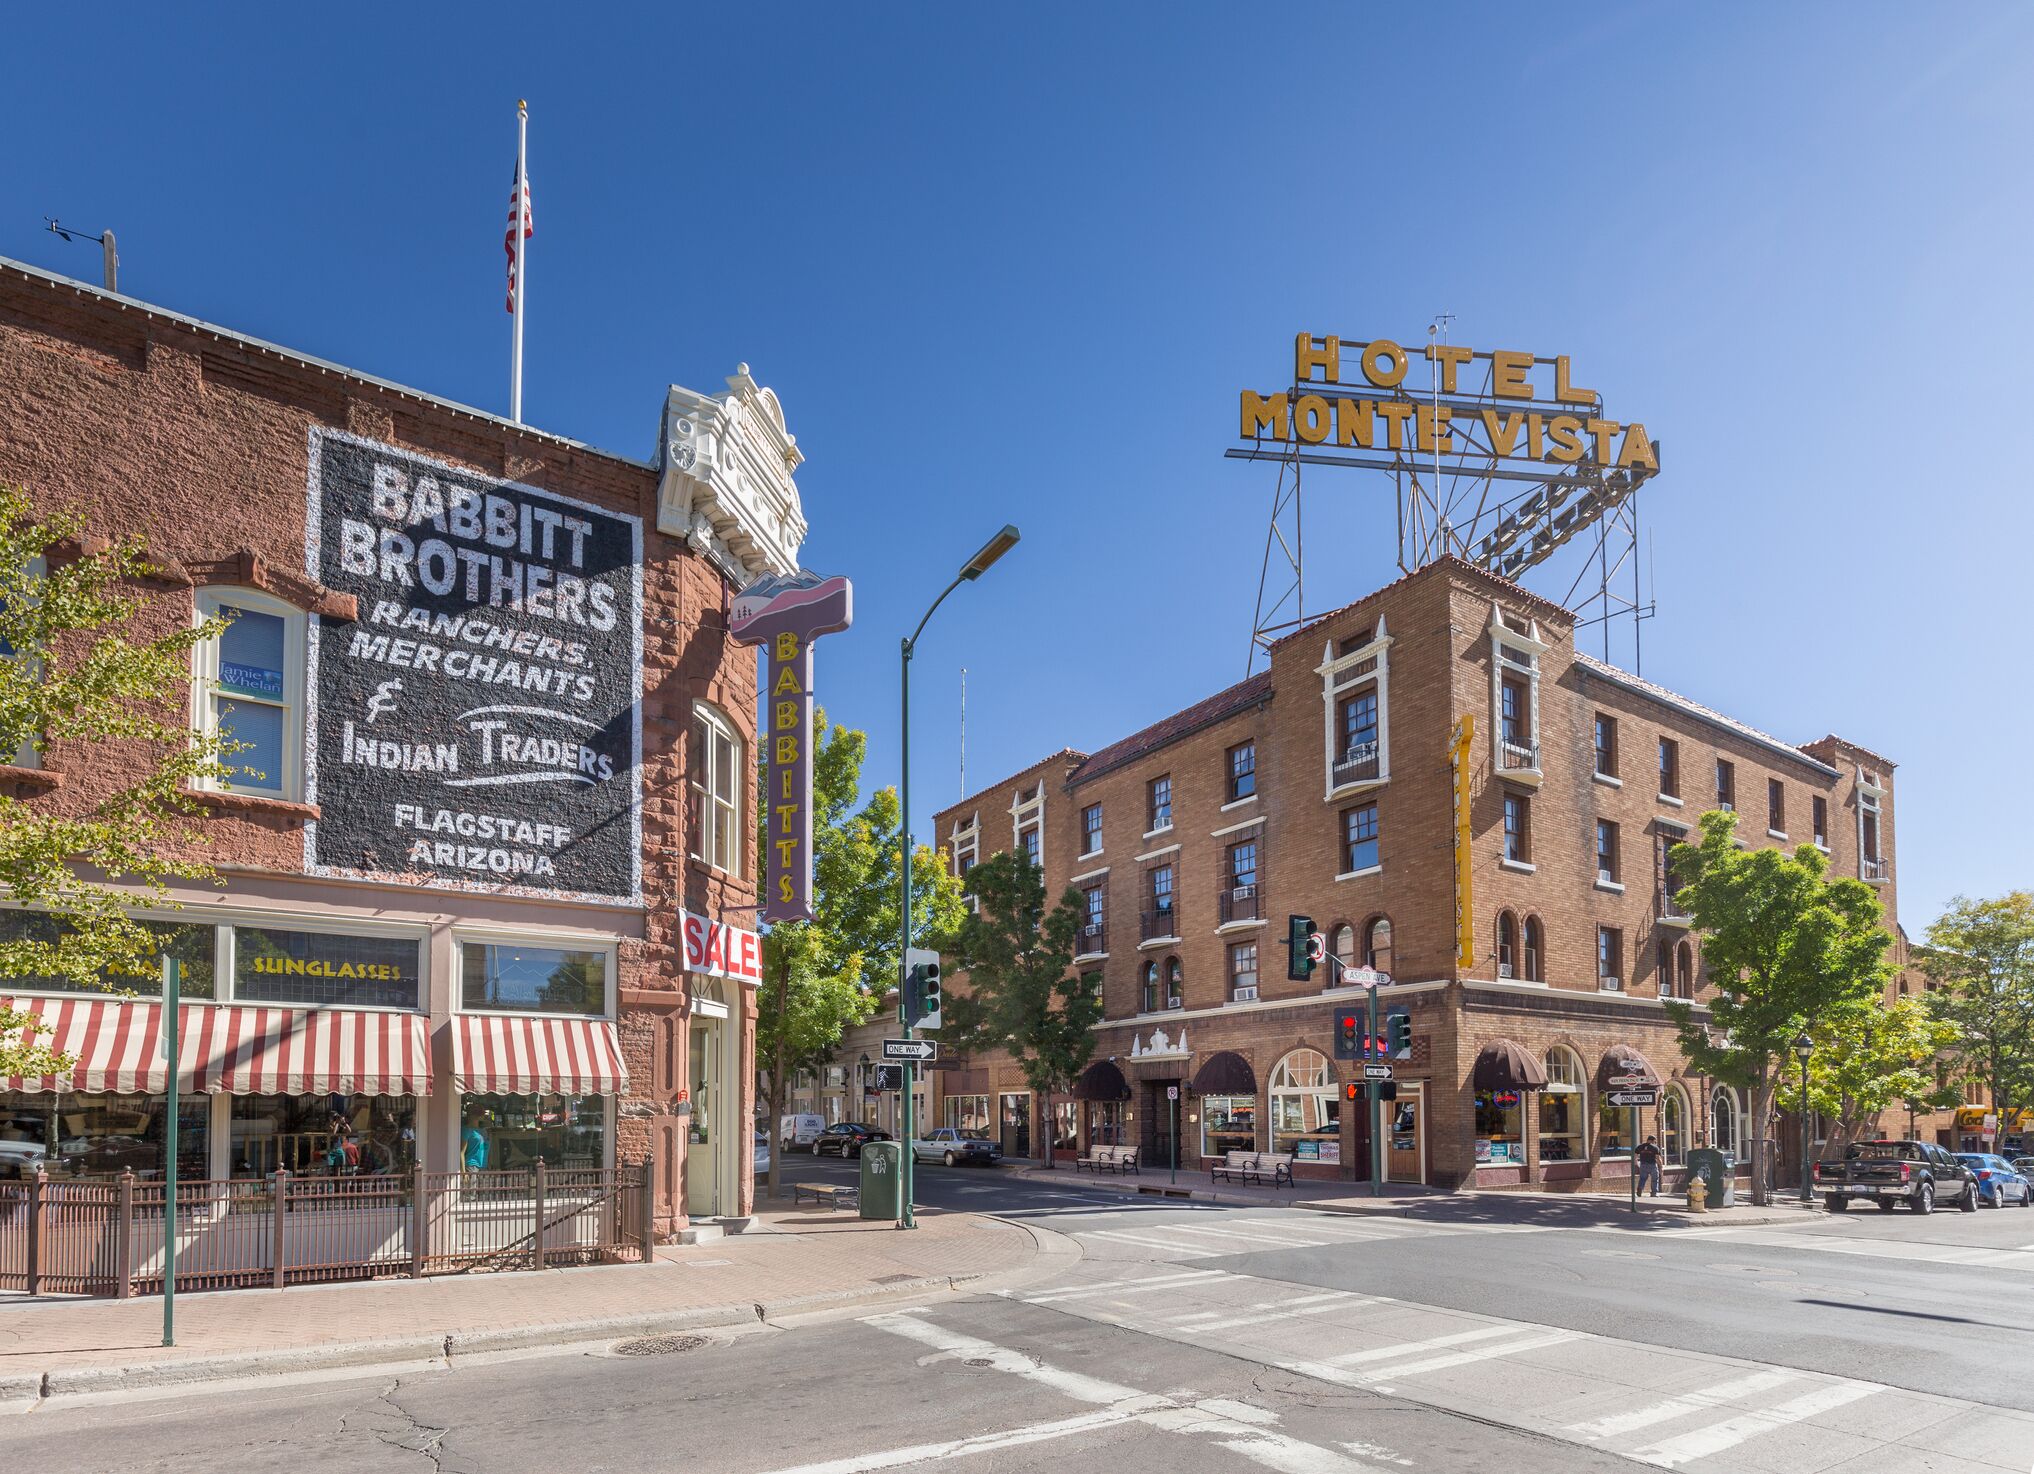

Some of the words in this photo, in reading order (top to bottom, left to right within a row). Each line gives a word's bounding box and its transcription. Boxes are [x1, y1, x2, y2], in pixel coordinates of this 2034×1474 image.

[1297, 332, 1597, 405] HOTEL
[1240, 390, 1452, 454] MONTE
[1481, 409, 1660, 470] VISTA
[373, 462, 593, 568] BABBITT
[341, 518, 618, 633] BROTHERS
[369, 600, 594, 669] RANCHERS,
[219, 662, 262, 680] Jamie
[224, 674, 281, 693] Whelan
[349, 630, 595, 701] MERCHANTS
[342, 720, 460, 772] INDIAN
[470, 720, 614, 782] TRADERS
[773, 631, 803, 905] BABBITTS
[394, 803, 572, 849] FLAGSTAFF
[409, 839, 556, 877] ARIZONA
[253, 956, 401, 981] SUNGLASSES
[1349, 971, 1371, 981] ASPEN
[1373, 973, 1386, 983] AVE
[888, 1045, 904, 1054] ONE
[905, 1045, 921, 1054] WAY
[1621, 1095, 1635, 1103] ONE
[1636, 1095, 1651, 1103] WAY
